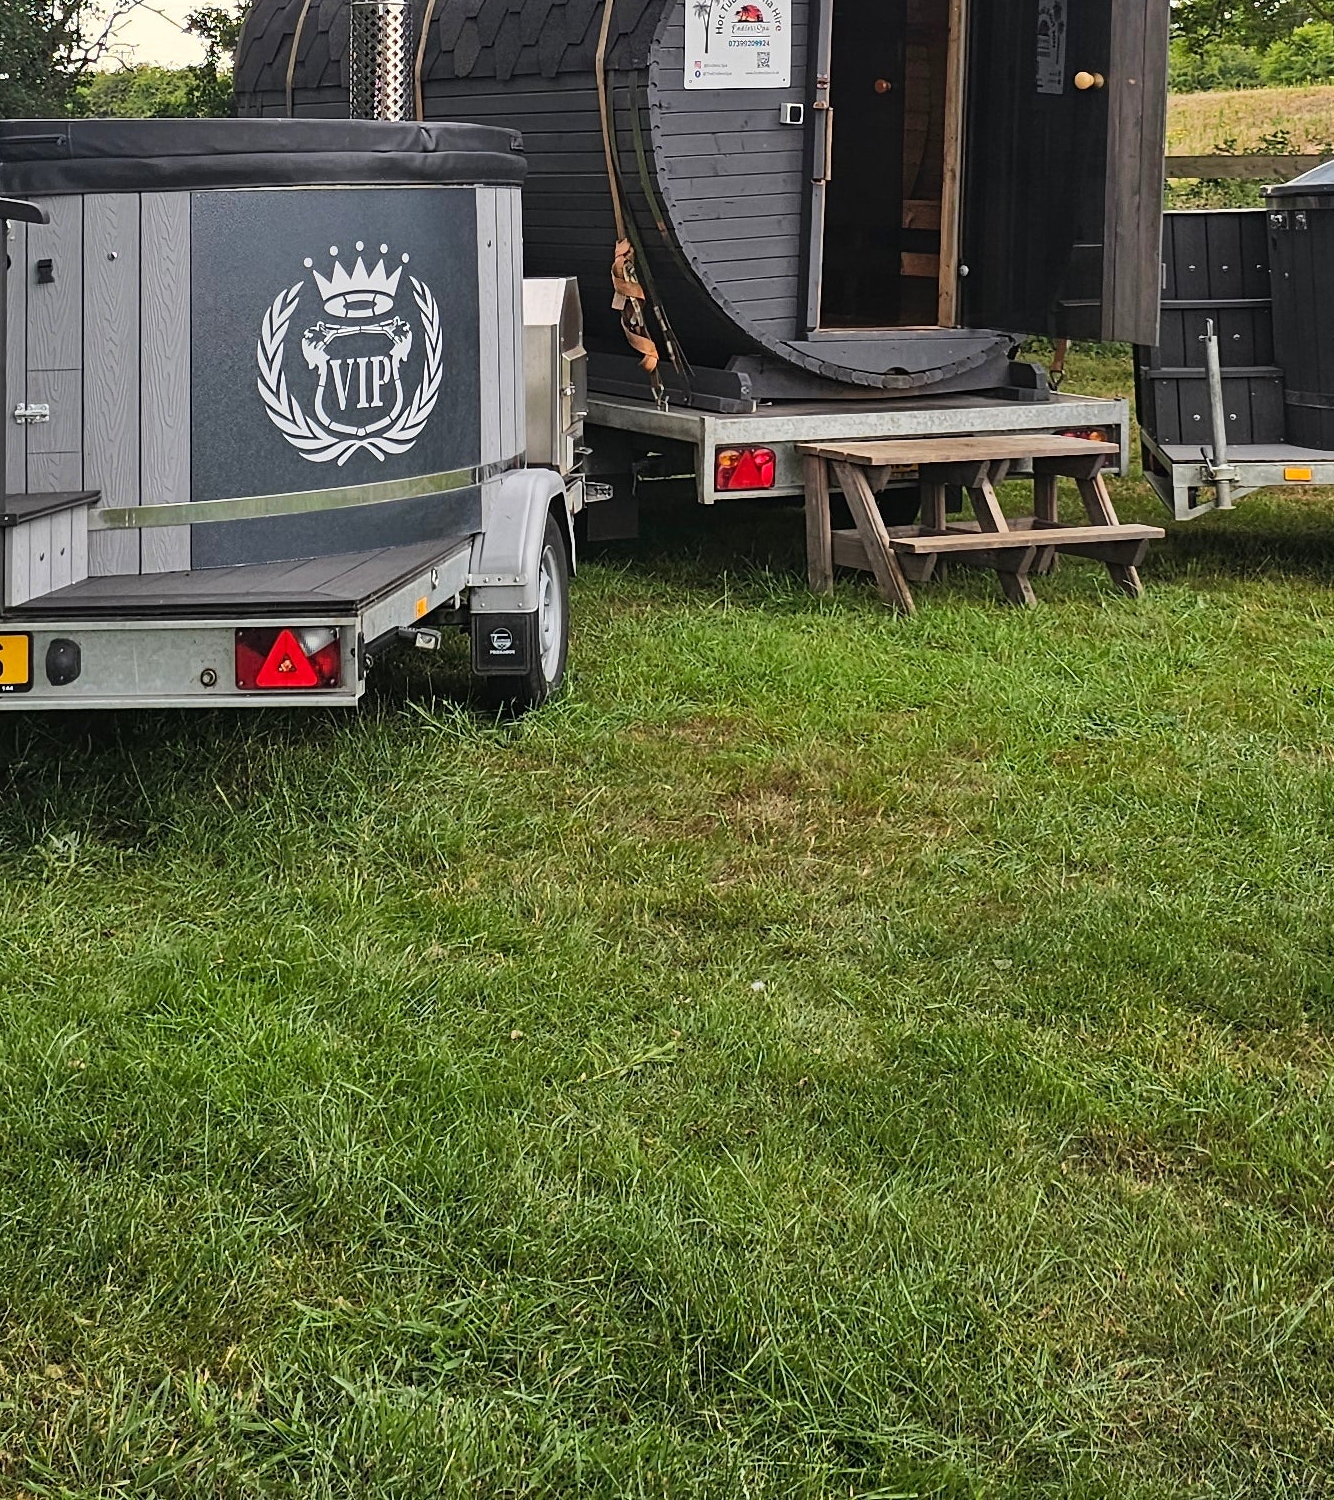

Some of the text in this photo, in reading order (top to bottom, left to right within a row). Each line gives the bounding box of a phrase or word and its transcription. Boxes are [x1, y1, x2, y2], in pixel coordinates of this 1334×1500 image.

[715, 14, 726, 35] Hot
[772, 8, 783, 32] Hire
[329, 356, 391, 411] VIP
